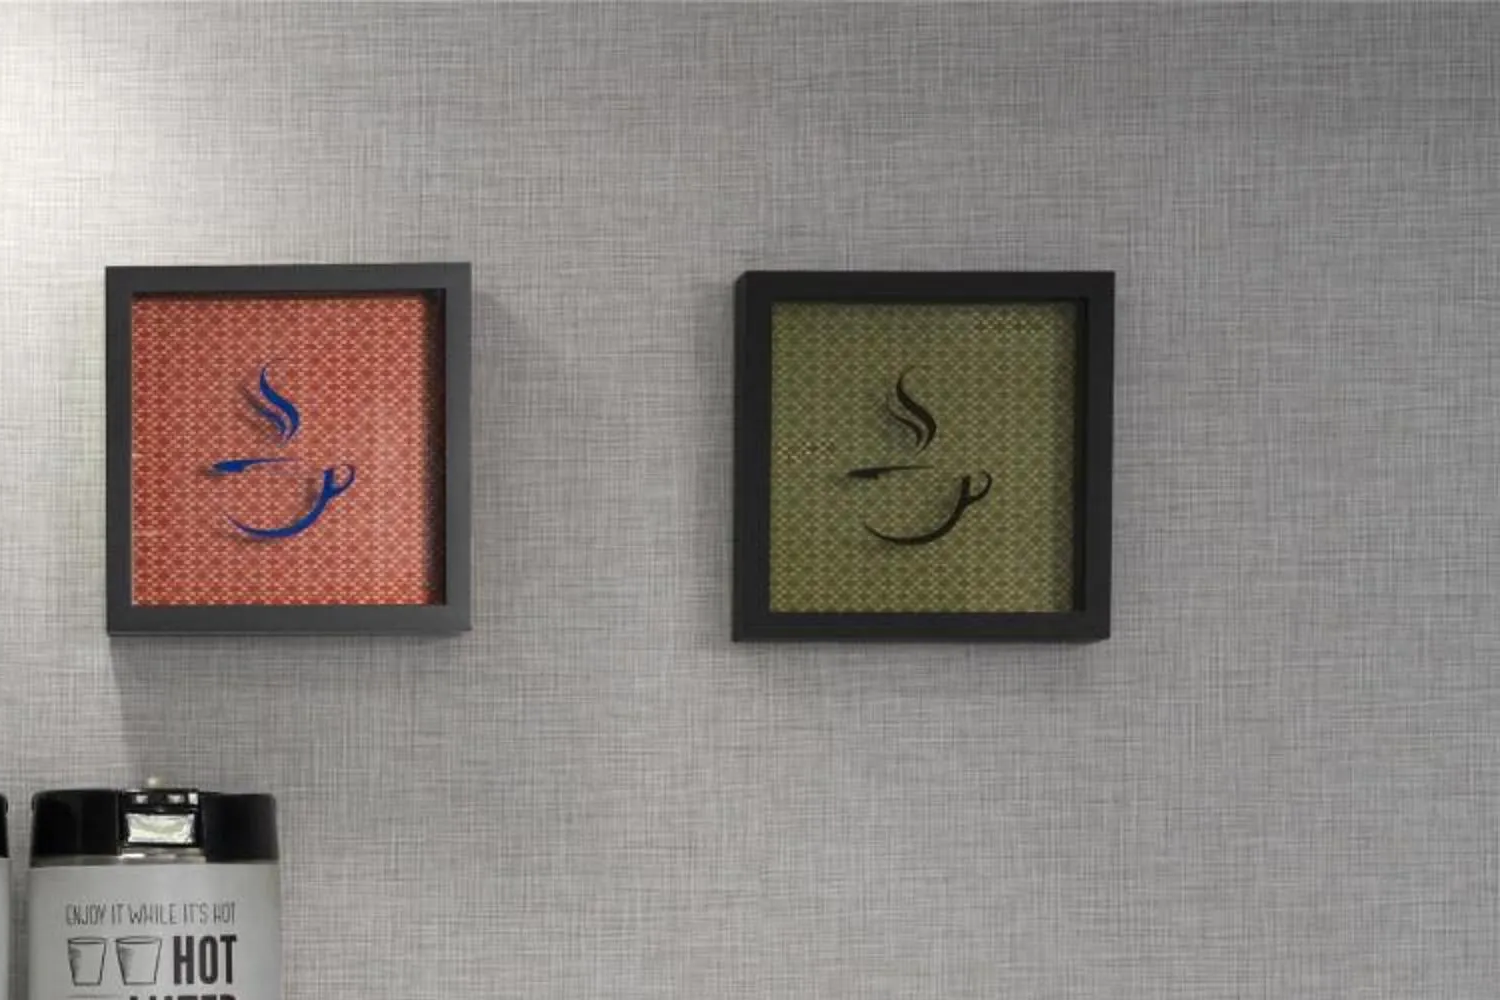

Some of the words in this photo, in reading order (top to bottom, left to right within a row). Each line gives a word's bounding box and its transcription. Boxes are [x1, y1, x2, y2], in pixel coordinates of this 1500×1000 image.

[65, 903, 106, 925] ENJOY
[111, 903, 124, 924] IT
[128, 903, 178, 925] WHILE
[183, 903, 209, 925] IT'S
[213, 903, 236, 925] HOT
[173, 934, 237, 985] HOT
